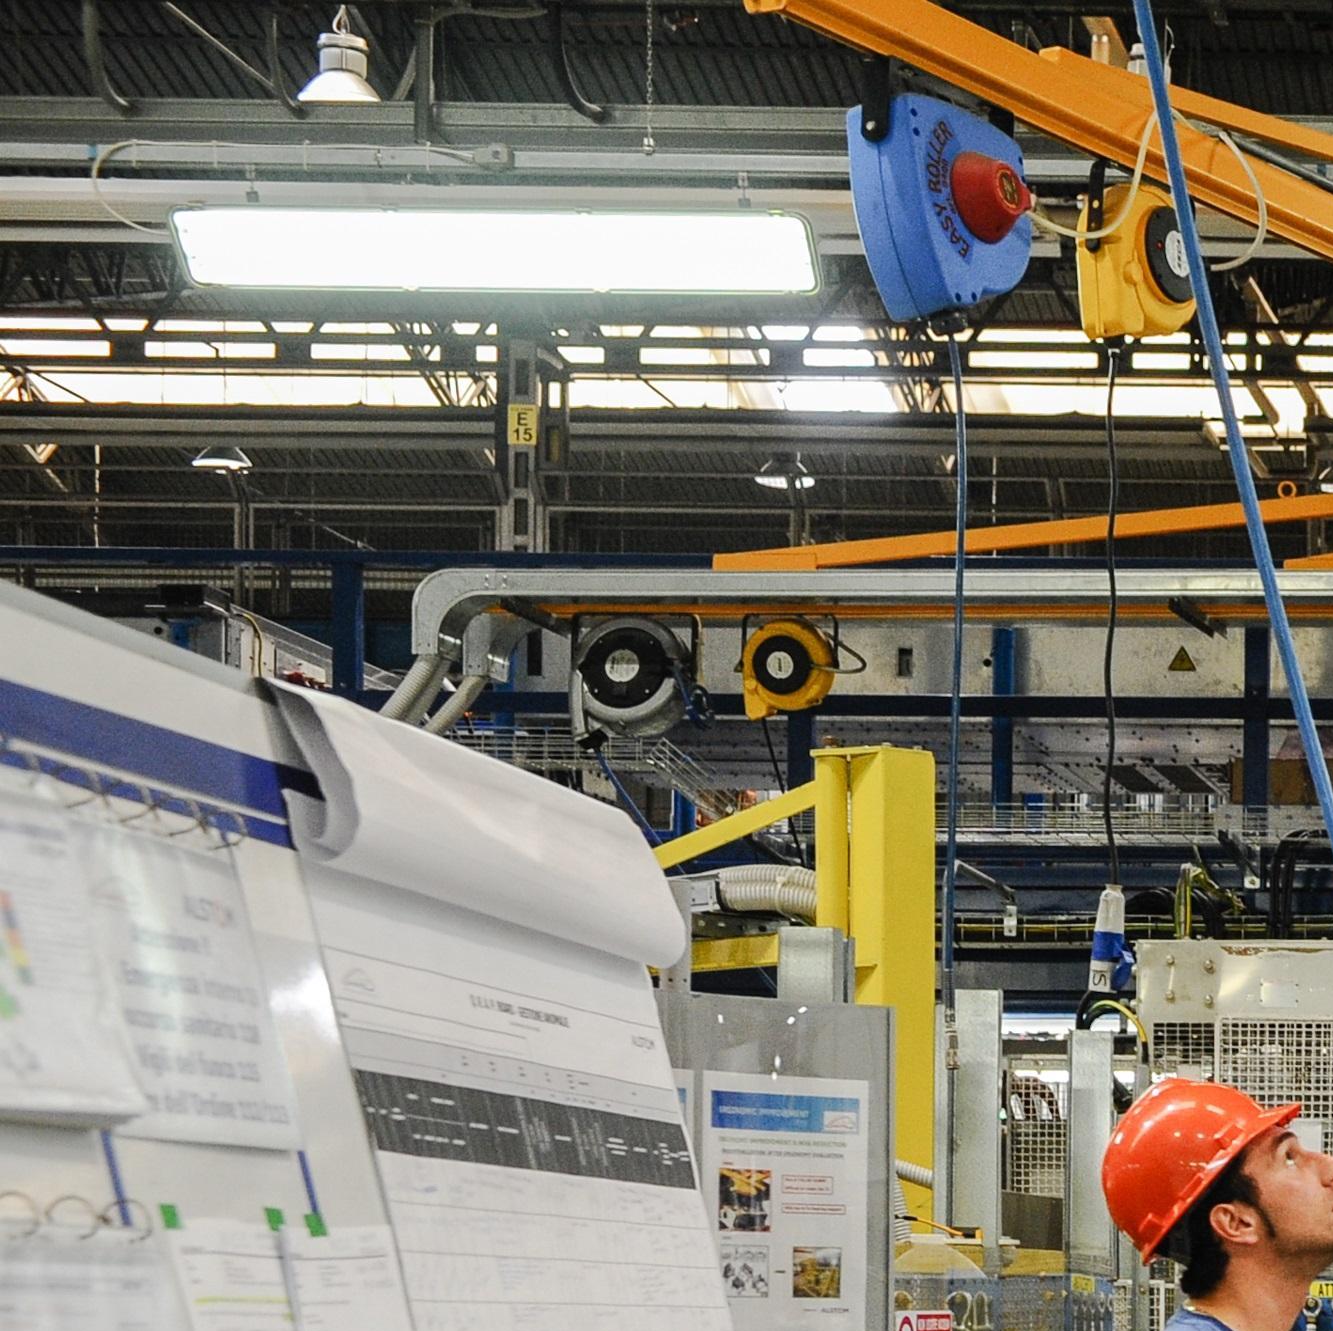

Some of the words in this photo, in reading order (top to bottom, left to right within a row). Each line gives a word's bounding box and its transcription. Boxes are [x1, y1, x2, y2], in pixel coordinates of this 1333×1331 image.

[927, 120, 954, 194] ROLLER
[517, 412, 528, 426] E
[513, 427, 533, 442] 15
